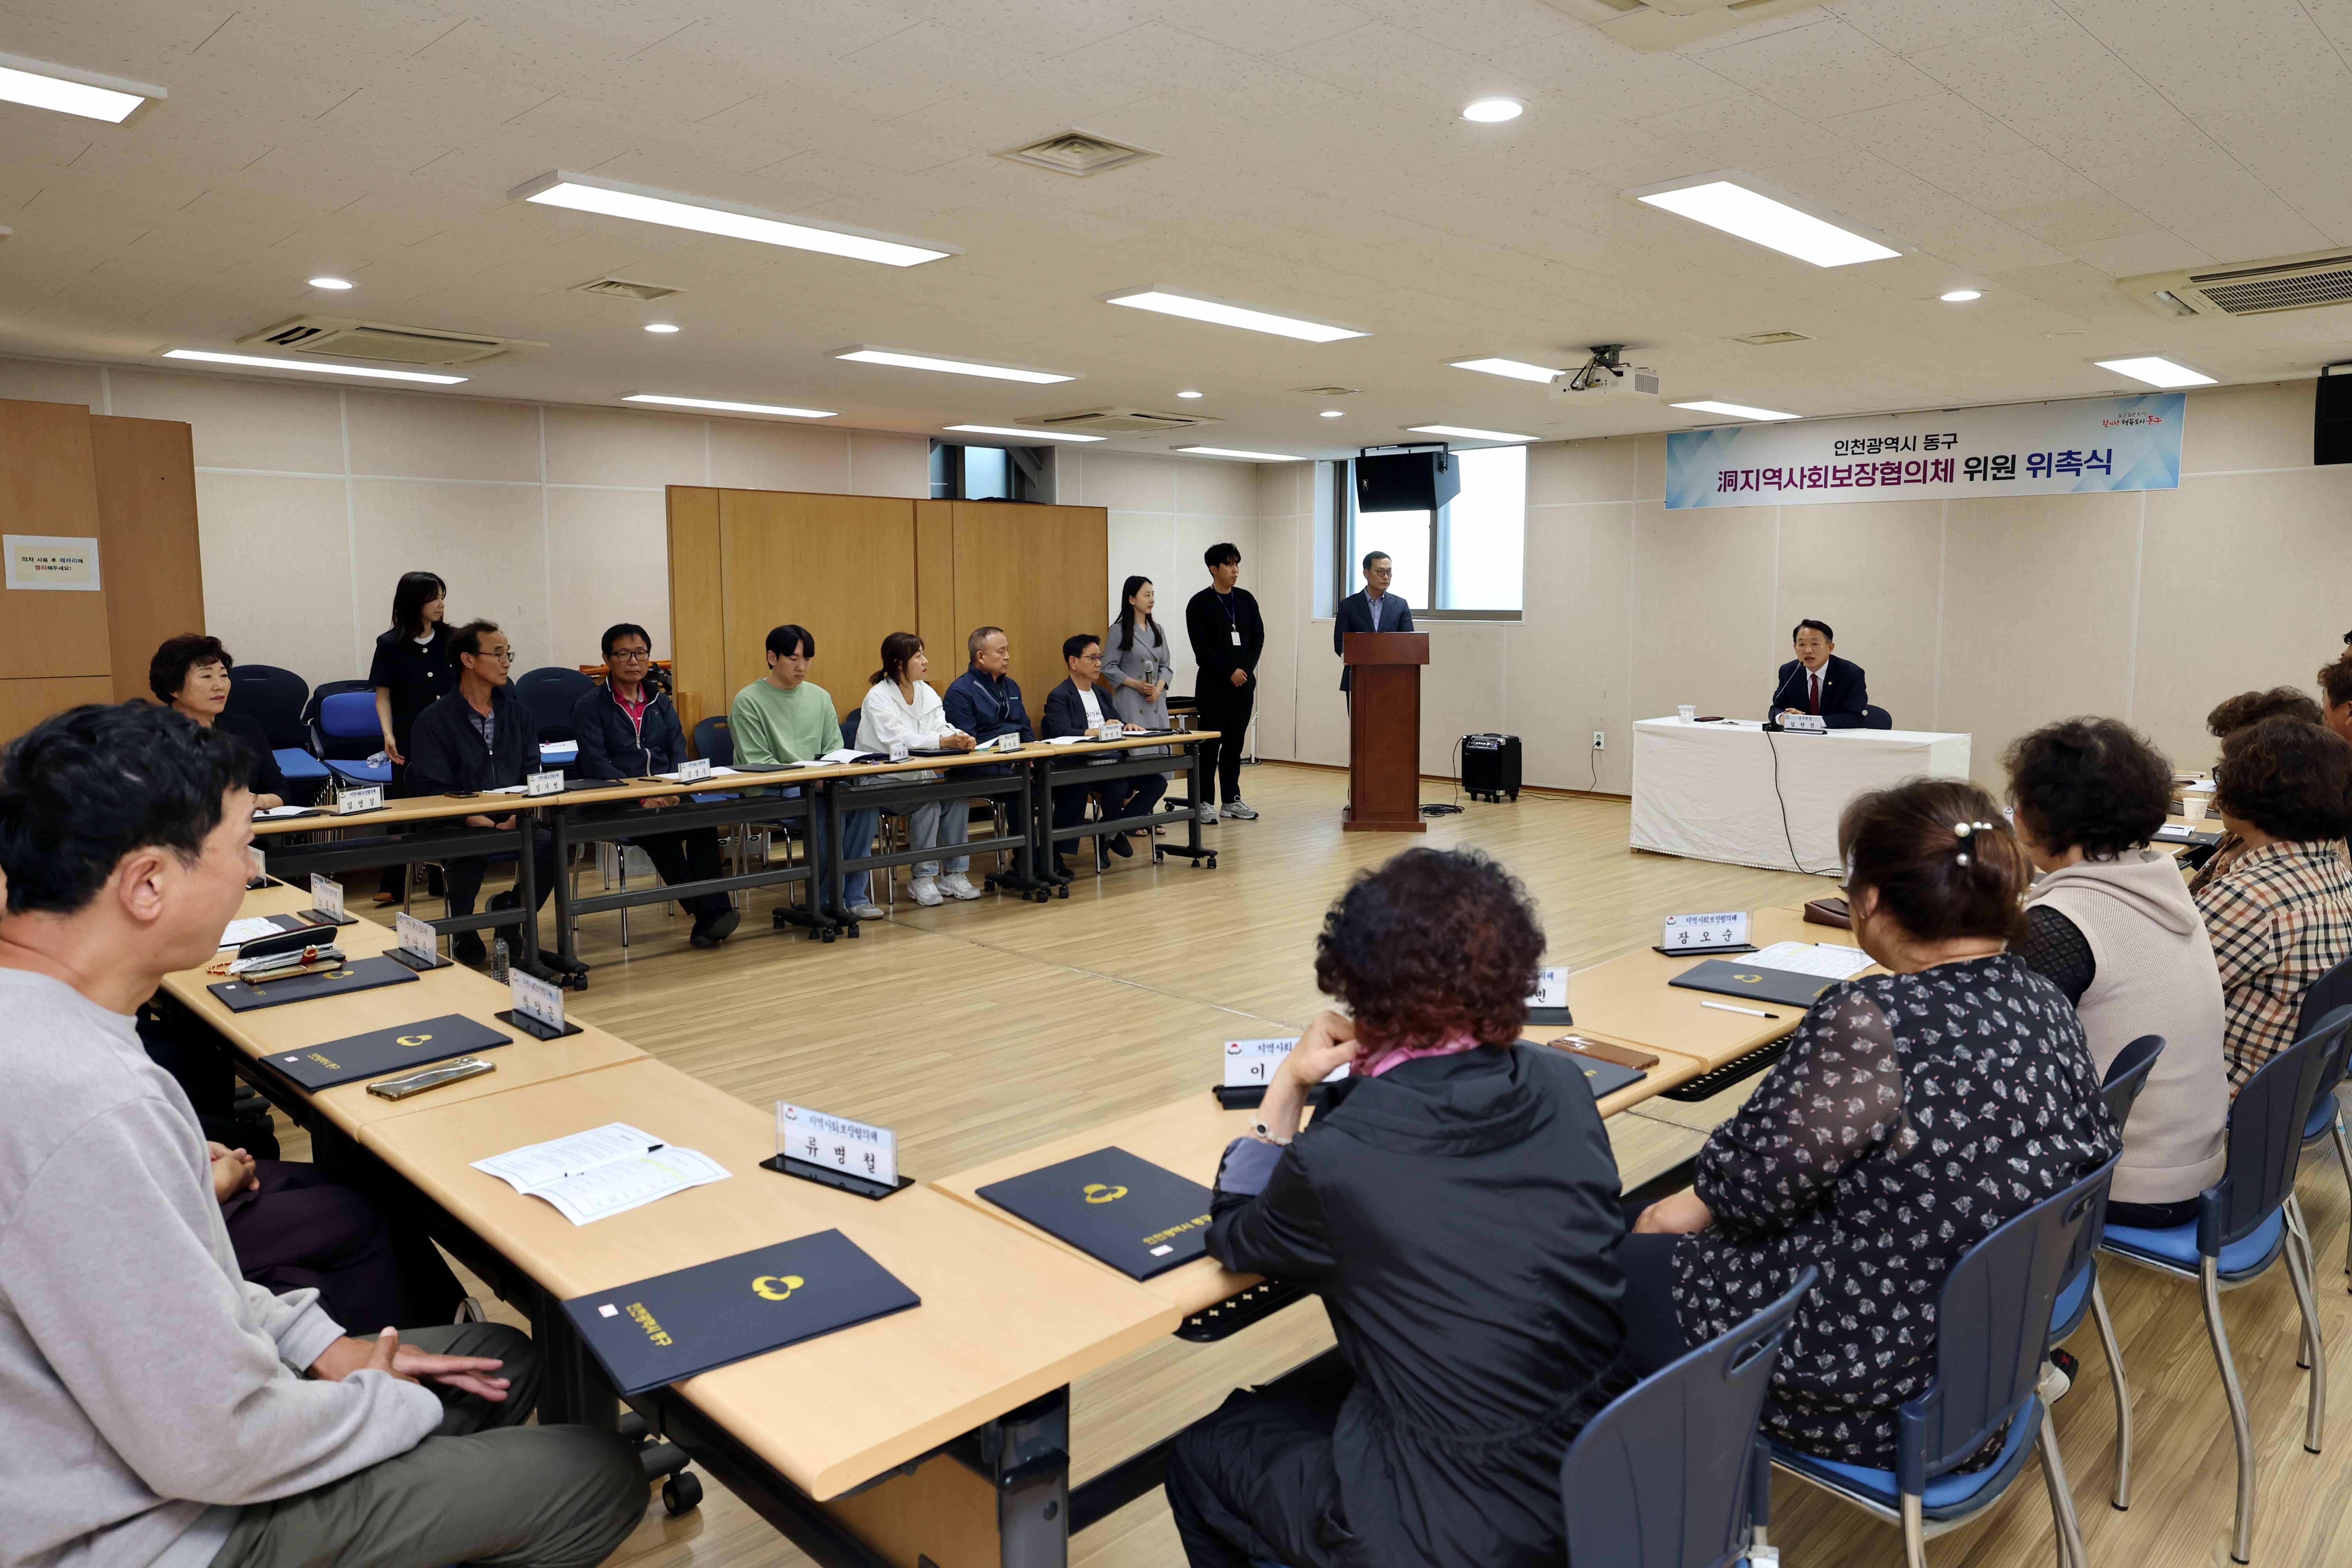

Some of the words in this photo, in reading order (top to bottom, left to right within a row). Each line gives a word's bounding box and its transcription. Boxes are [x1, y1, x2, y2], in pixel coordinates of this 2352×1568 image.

[2146, 416, 2162, 425] 동구
[1834, 435, 1916, 457] 인천광역시
[1923, 433, 1958, 451] 동구
[1717, 458, 1955, 493] 洞지역사회보장협의체
[1963, 454, 2017, 482] 위원
[2025, 448, 2113, 478] 위촉식
[1257, 1042, 1292, 1054] 지역사회
